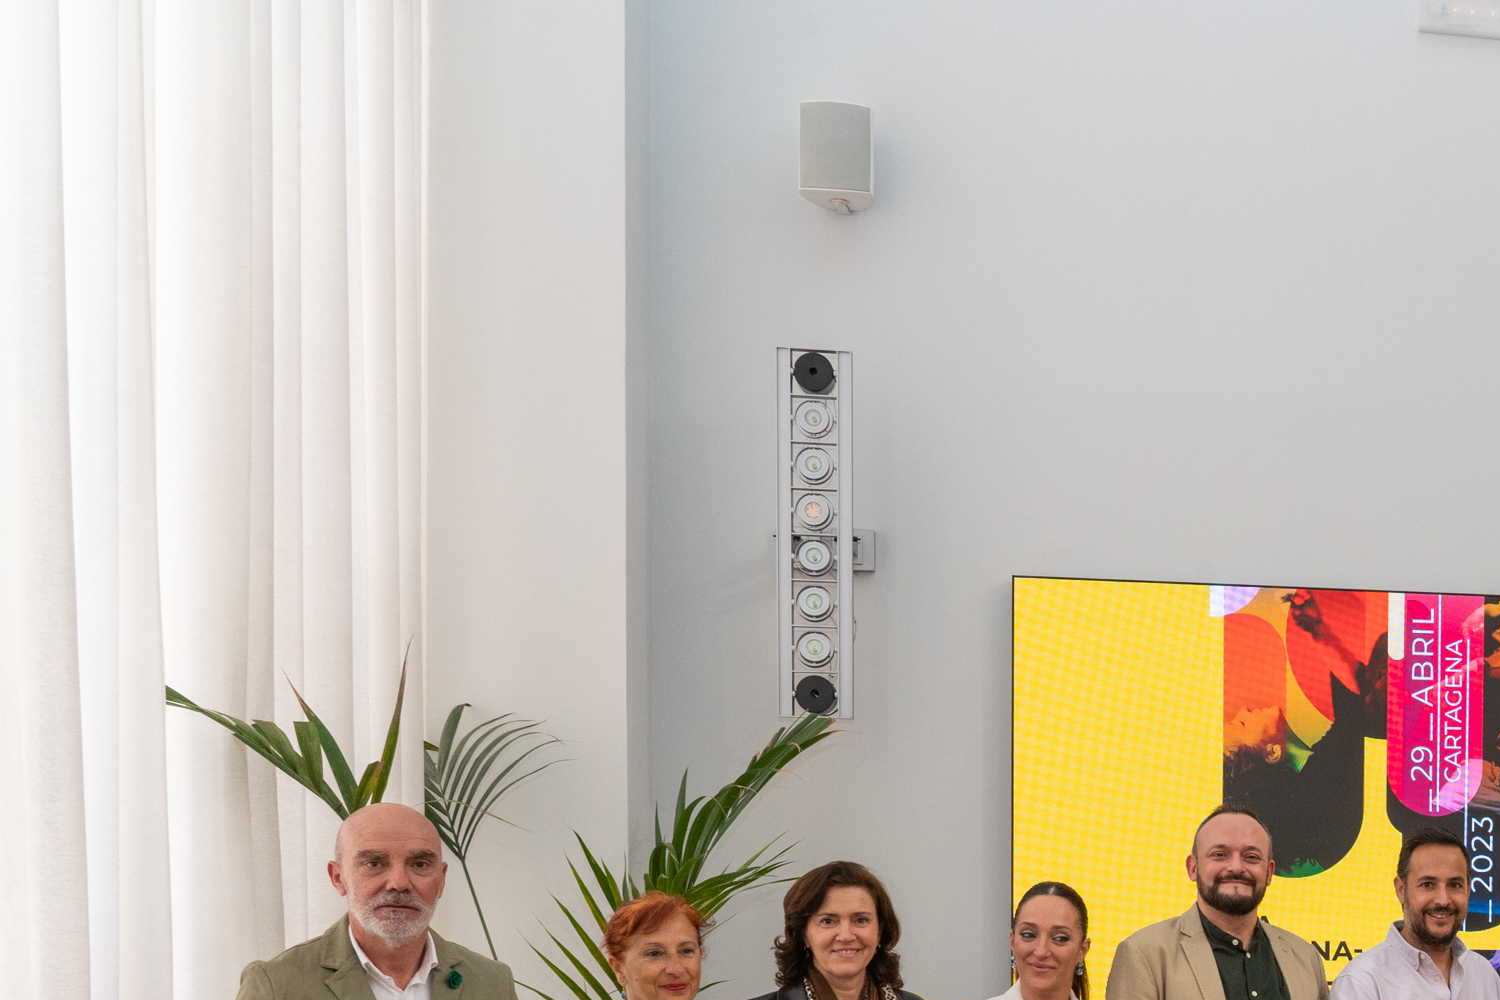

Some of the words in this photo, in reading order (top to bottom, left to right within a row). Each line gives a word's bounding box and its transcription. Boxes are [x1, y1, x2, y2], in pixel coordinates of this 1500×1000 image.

[1411, 607, 1435, 707] ABRIL
[1443, 638, 1463, 783] CARTAGENA
[1410, 745, 1433, 781] 29
[1471, 816, 1494, 893] 2023
